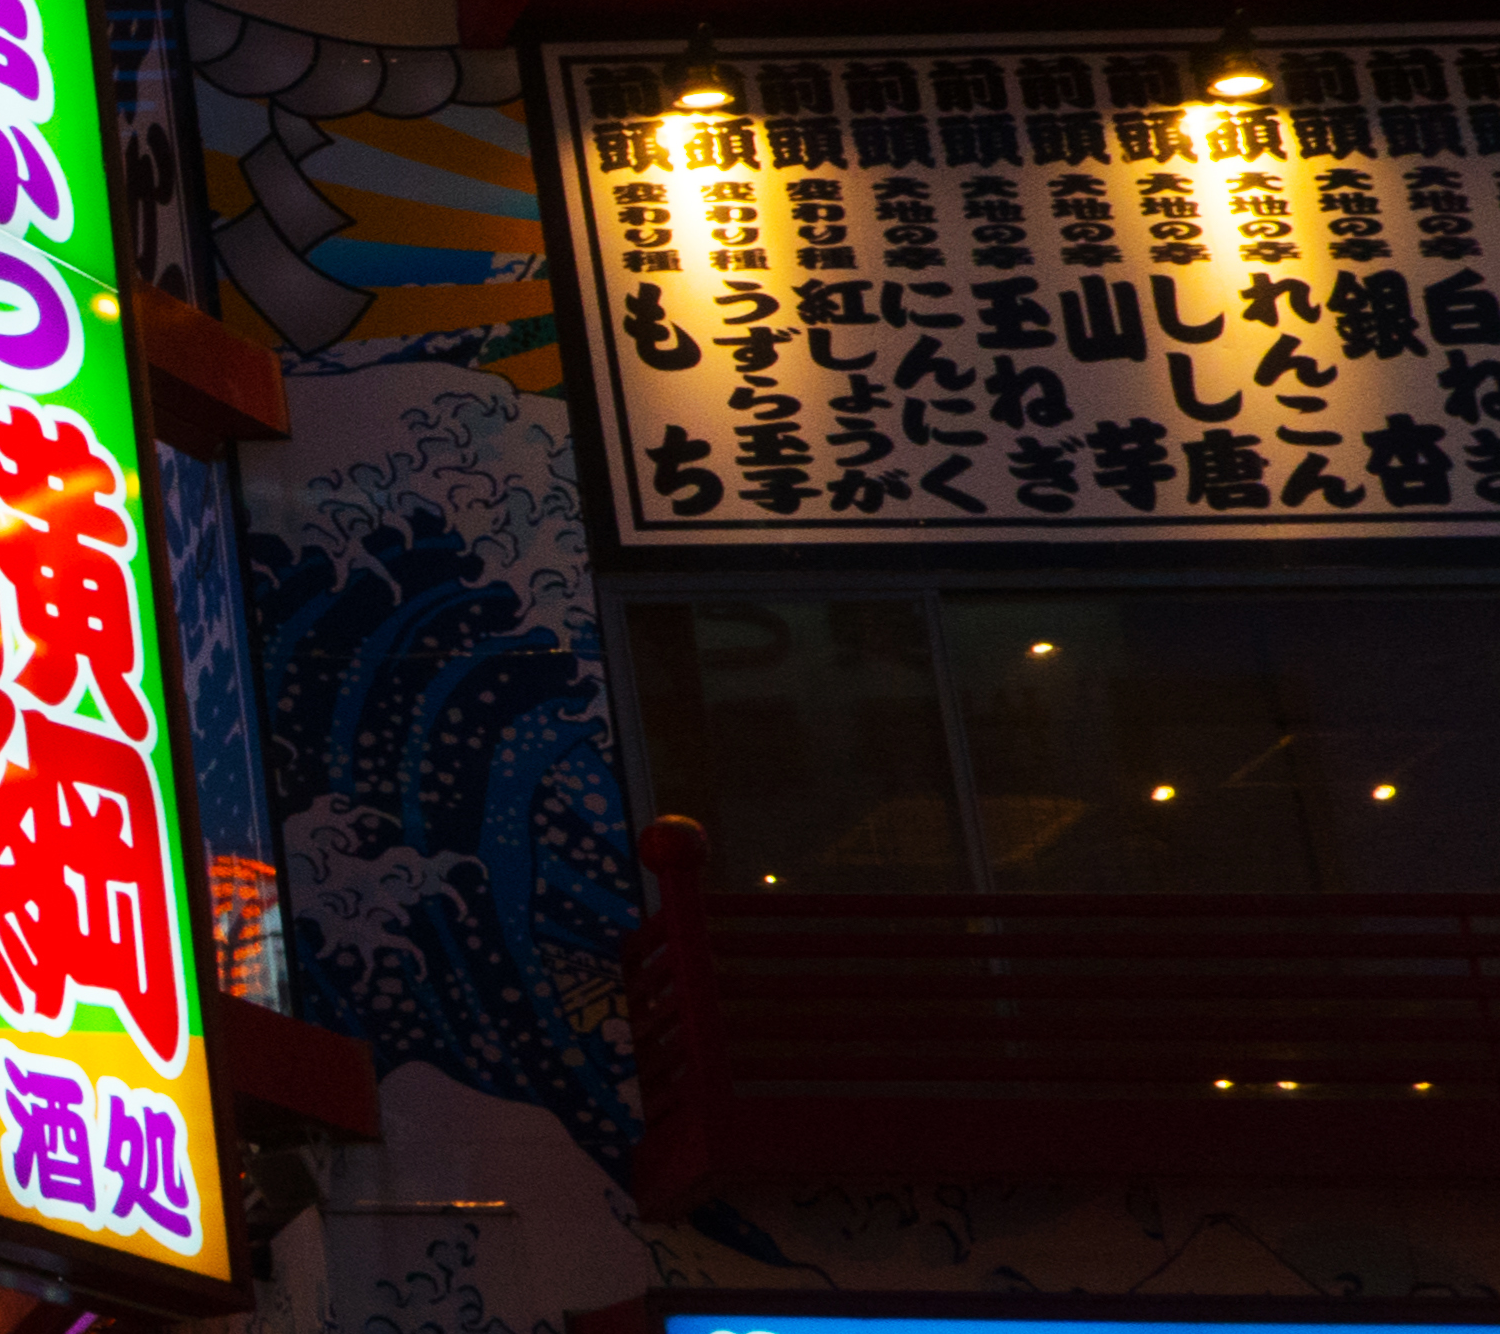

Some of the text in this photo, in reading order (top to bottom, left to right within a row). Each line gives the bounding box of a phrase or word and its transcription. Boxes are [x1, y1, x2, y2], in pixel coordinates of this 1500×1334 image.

[841, 61, 937, 171] 前頭
[930, 59, 1024, 172] 前頭
[1016, 56, 1112, 167] 前頭
[1103, 54, 1199, 164] 前頭
[1279, 51, 1378, 161] 前頭
[1366, 47, 1467, 160] 前頭
[585, 66, 723, 516] 前頭 変わり種 もち
[701, 181, 771, 272] 変わり種
[759, 63, 910, 515] 前頭 変わり種 紅しょうが
[713, 280, 824, 515] うずら玉子
[881, 279, 987, 515] にんにく
[971, 277, 1082, 515] 玉ねぎ
[1060, 274, 1176, 513] 山芋
[1150, 272, 1271, 511] しし唐
[1240, 270, 1365, 509] れんこん
[1326, 268, 1453, 509] 銀杏
[2, 1055, 194, 1242] 酒処
